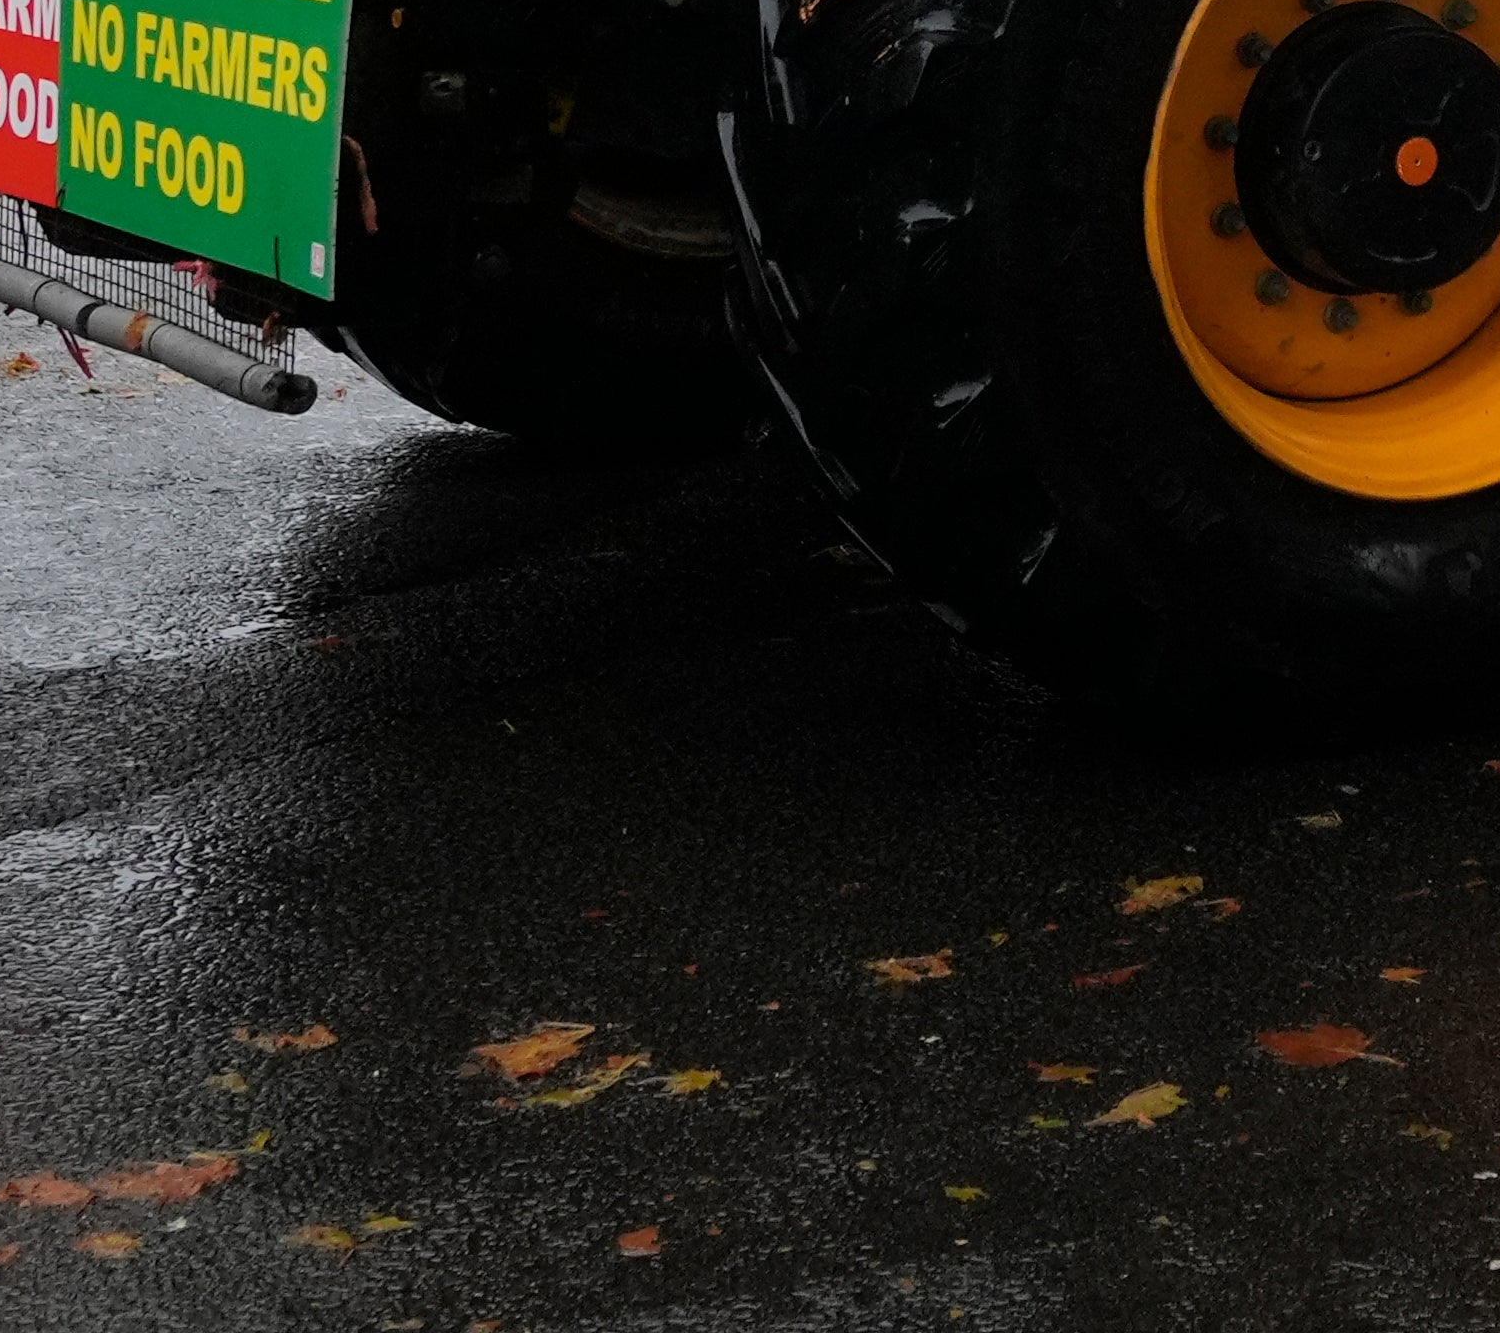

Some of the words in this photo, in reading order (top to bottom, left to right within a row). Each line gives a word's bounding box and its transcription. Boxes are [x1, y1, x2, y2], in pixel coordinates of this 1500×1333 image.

[135, 11, 327, 122] FARMERS
[70, 102, 122, 179] NO
[135, 120, 244, 215] FOOD
